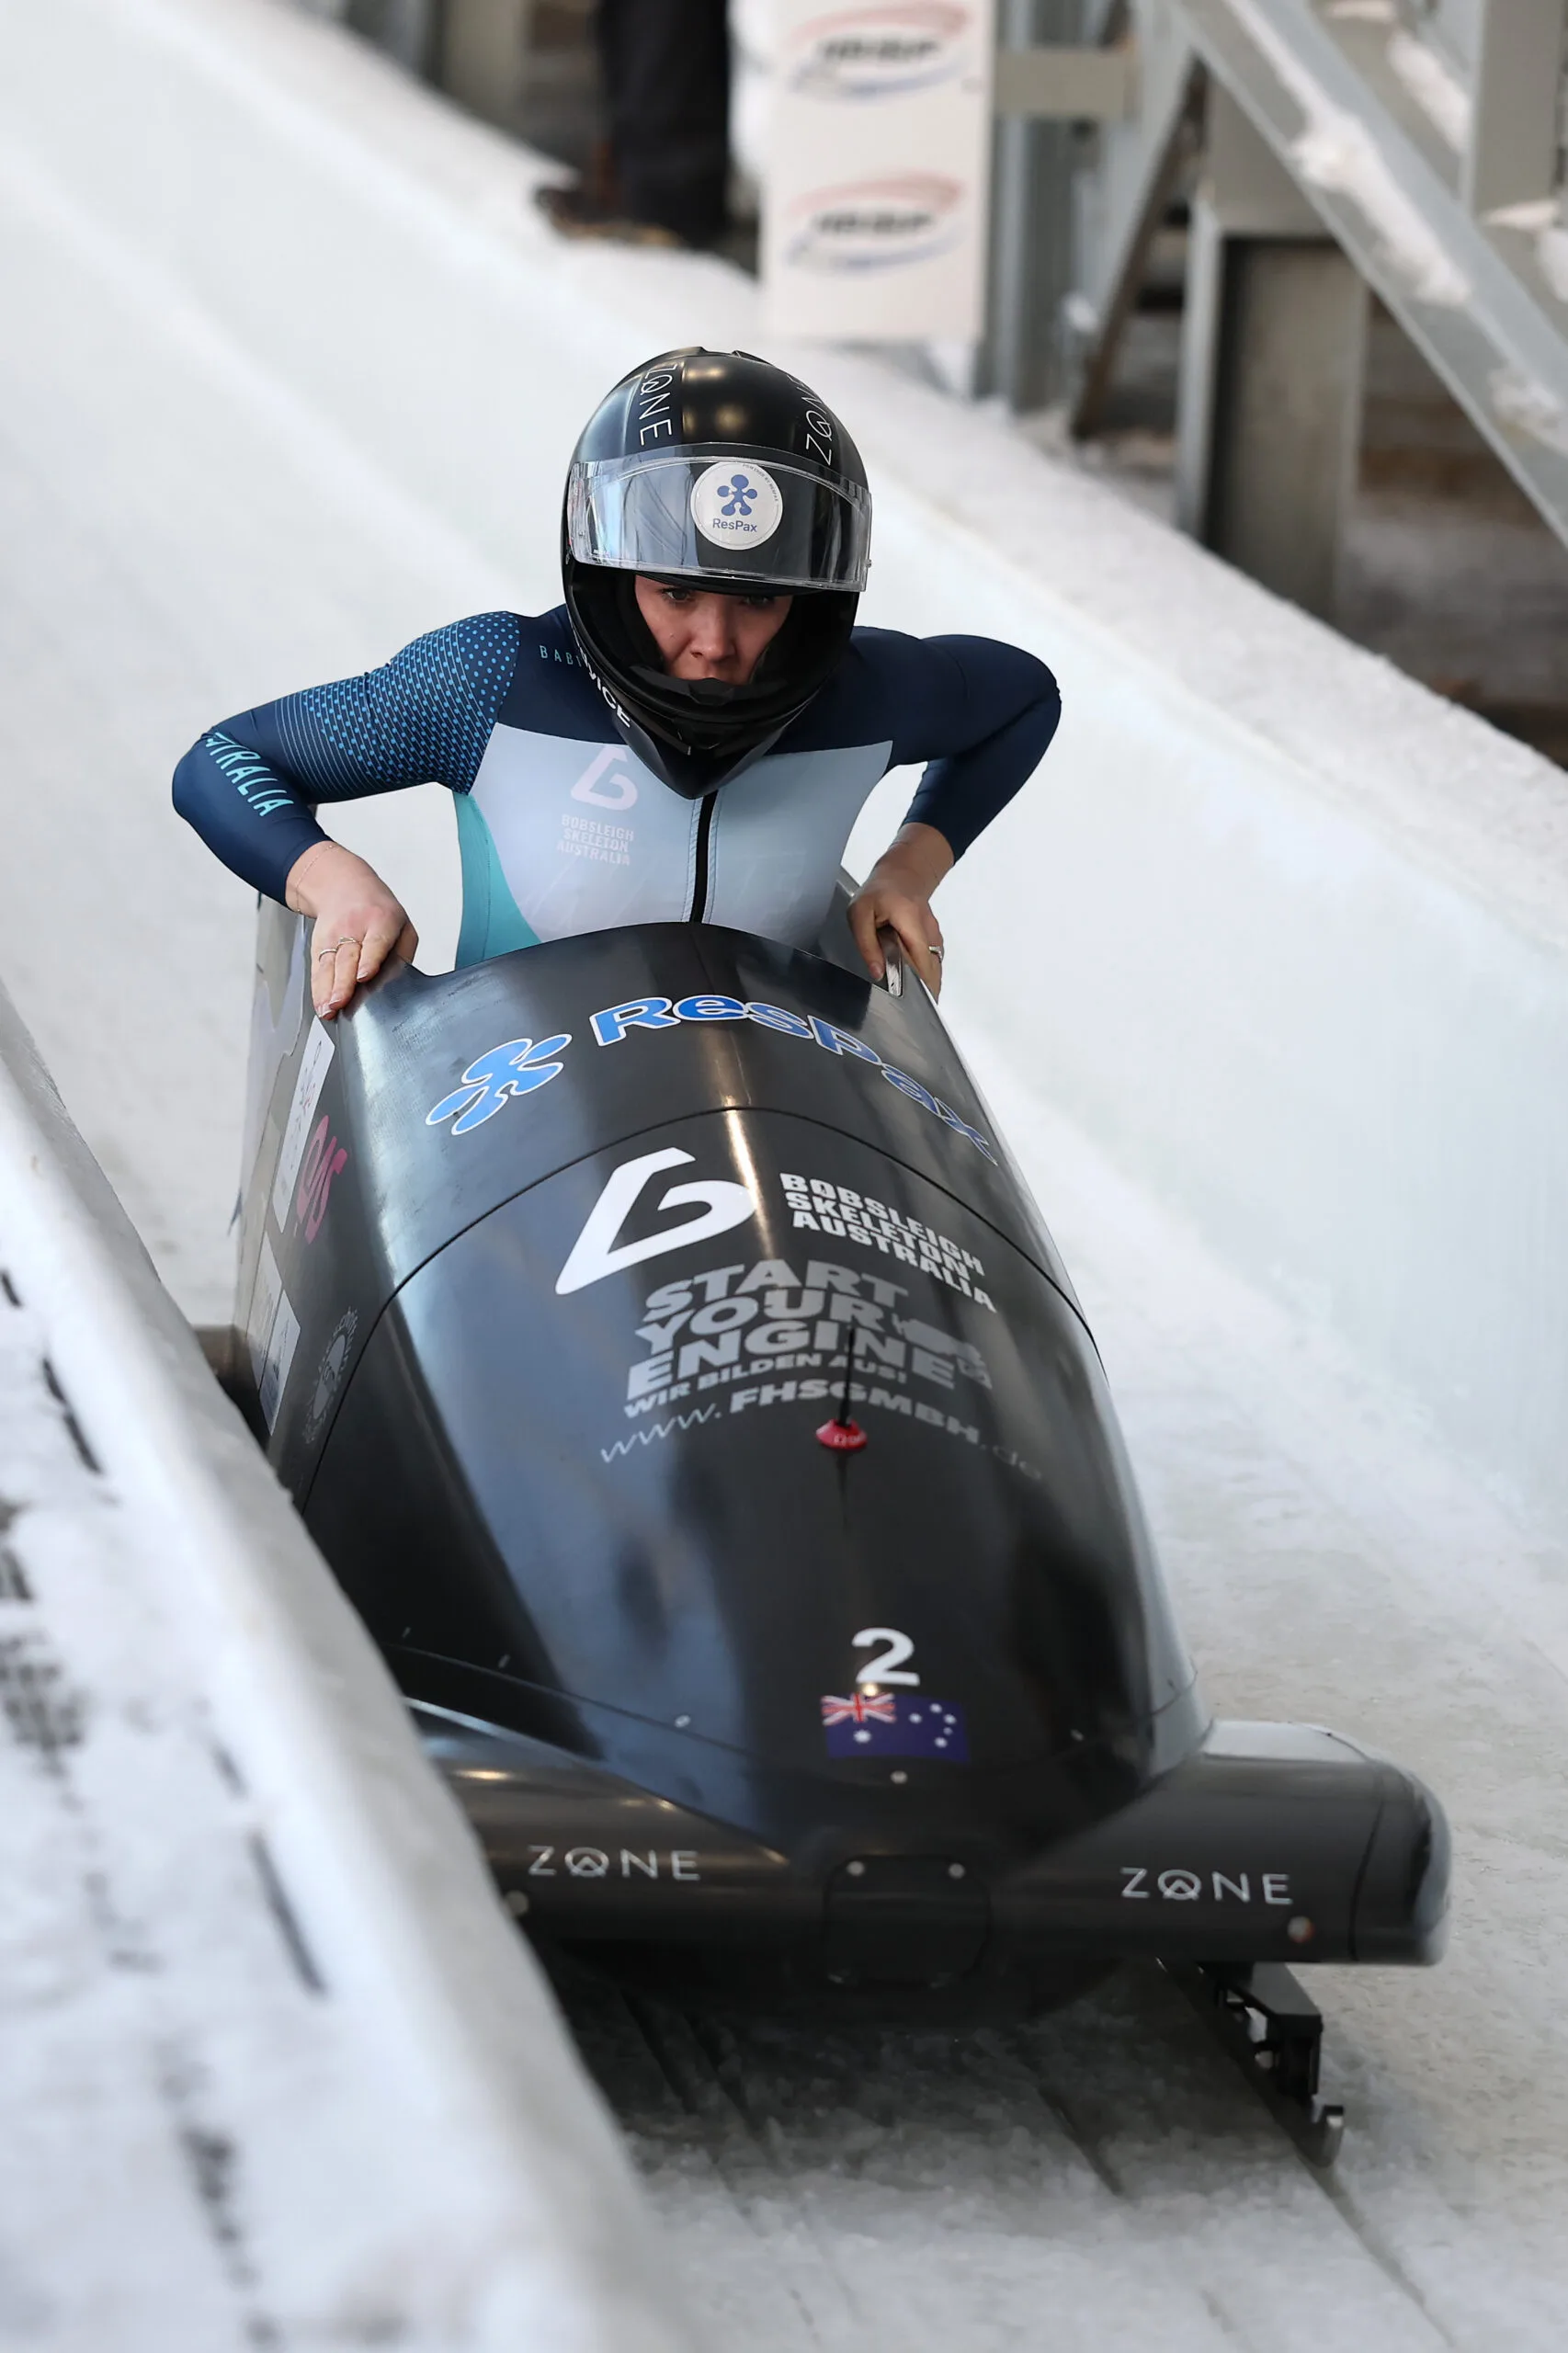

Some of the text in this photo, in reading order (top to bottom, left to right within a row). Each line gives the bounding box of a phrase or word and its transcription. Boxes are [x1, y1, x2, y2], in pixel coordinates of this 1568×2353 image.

[639, 363, 678, 446] ZONE
[712, 517, 758, 533] ResPax
[539, 644, 583, 668] BABI
[205, 732, 295, 817] TRALIA
[555, 839, 630, 866] AUSTRALIA
[562, 813, 634, 843] BOBSLEIGH
[562, 827, 630, 852] SKELETON
[588, 994, 999, 1167] ResPax
[779, 1173, 985, 1277] BOBSLEIGH
[786, 1191, 971, 1280] SKELETON
[642, 1259, 909, 1322] START
[793, 1210, 997, 1313] AUSTRALIA
[635, 1289, 886, 1355] YOUR
[624, 1381, 691, 1418] WIR
[697, 1353, 823, 1391] BILDEN
[851, 1627, 920, 1687] 2
[528, 1844, 700, 1881] ZONE
[1120, 1867, 1292, 1904] ZONE
